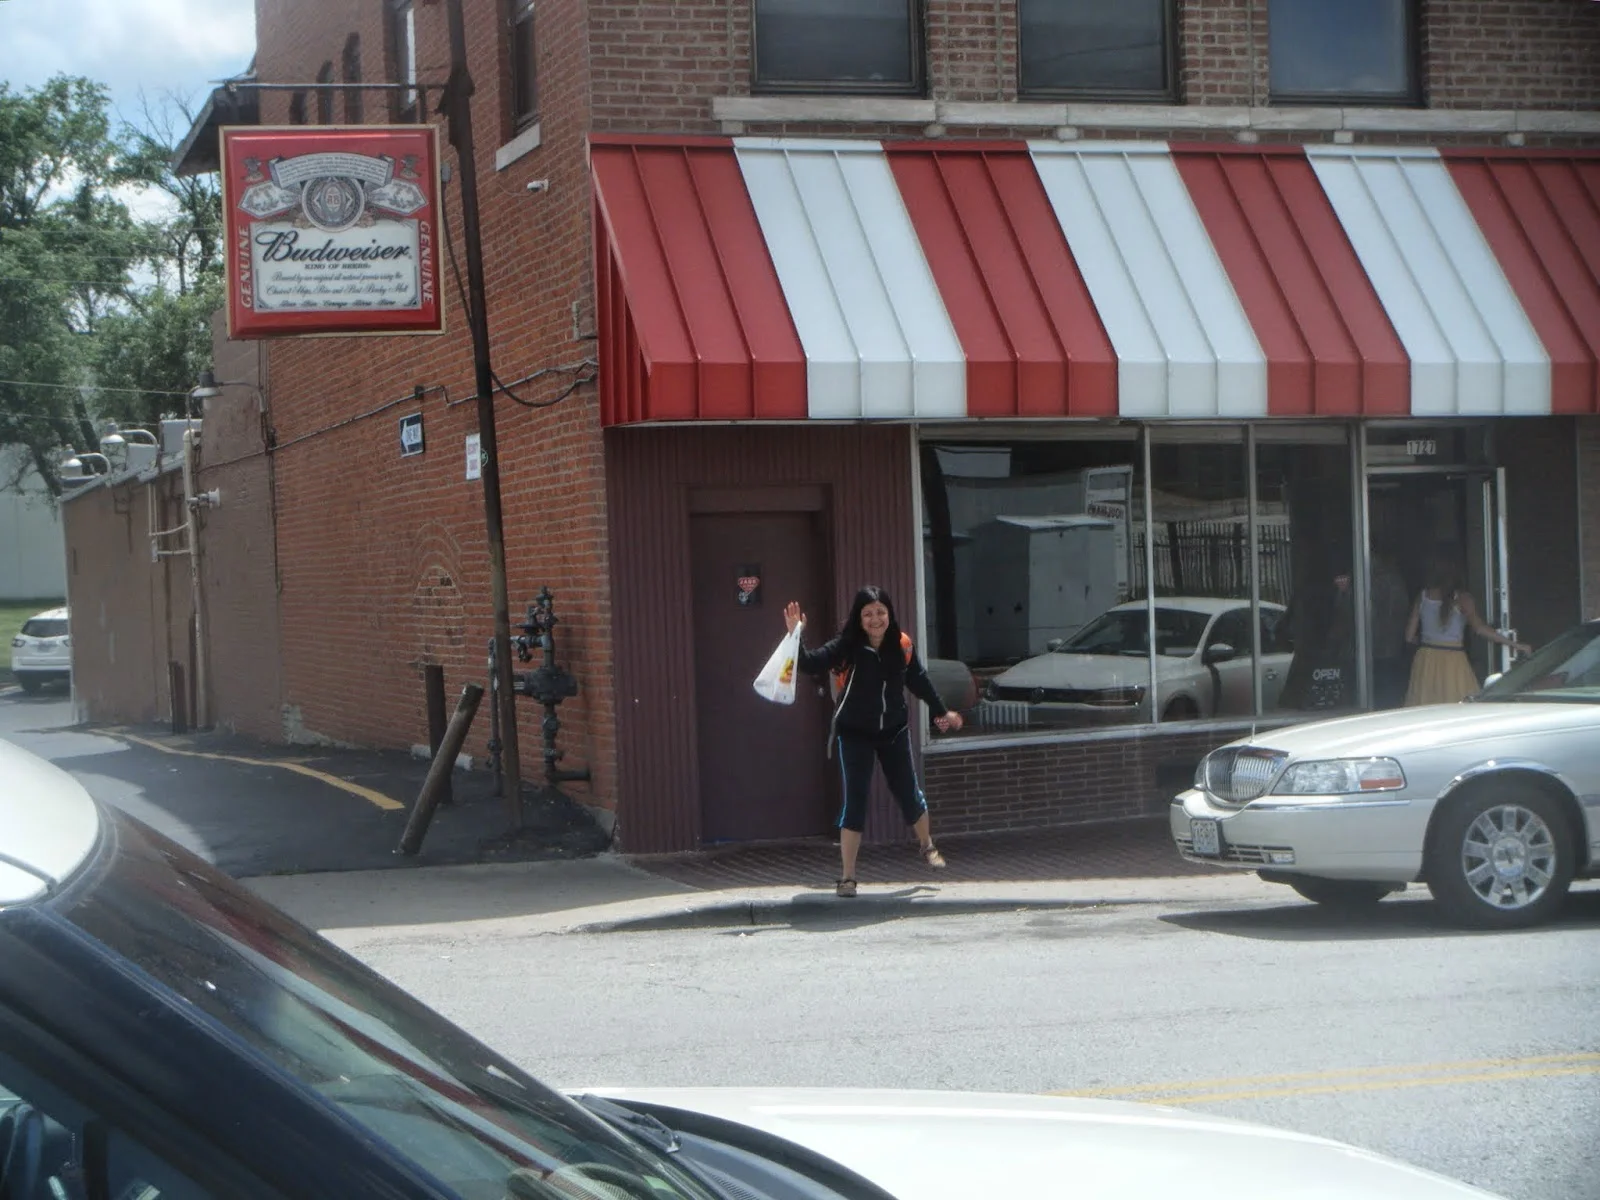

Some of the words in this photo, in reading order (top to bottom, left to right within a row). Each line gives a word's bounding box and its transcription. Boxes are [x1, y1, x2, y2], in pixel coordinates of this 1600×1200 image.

[255, 230, 410, 262] Budweiser
[420, 220, 435, 304] GENUINE
[238, 225, 251, 308] GENUINE
[1408, 440, 1435, 455] 1727
[1312, 668, 1340, 680] OPEN
